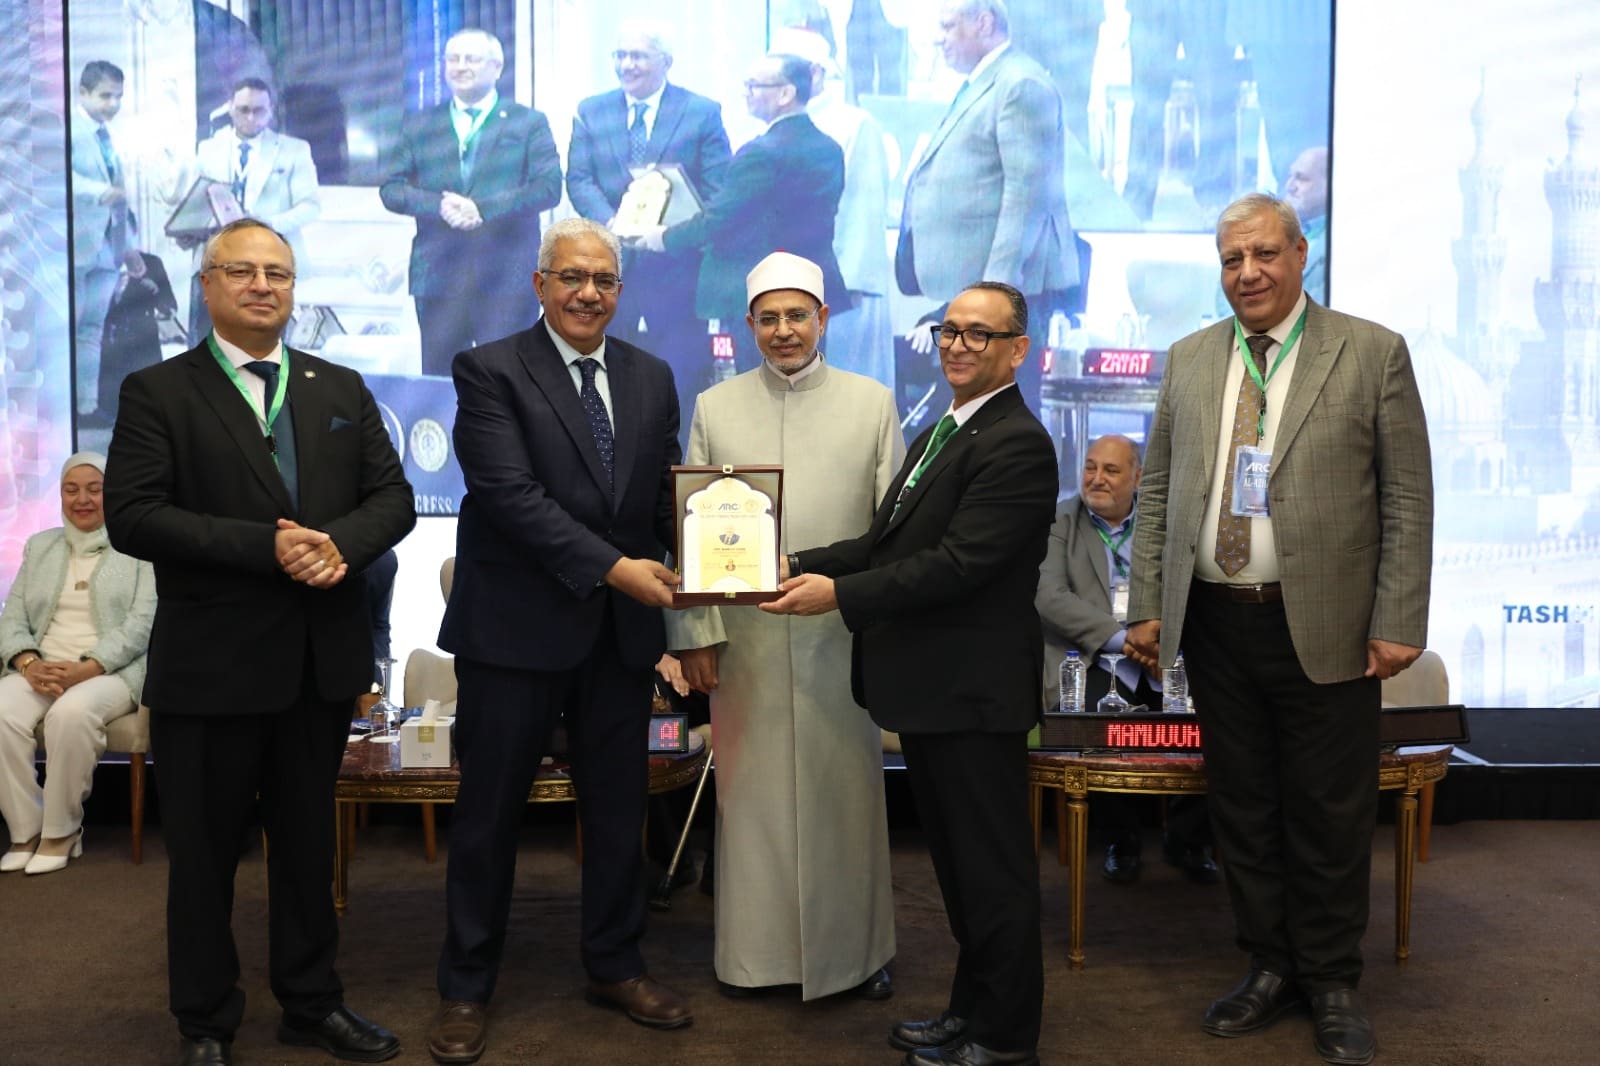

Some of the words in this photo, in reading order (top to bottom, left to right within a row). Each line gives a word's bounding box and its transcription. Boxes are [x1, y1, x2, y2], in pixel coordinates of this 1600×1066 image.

[1100, 351, 1151, 374] ZAYAT
[414, 495, 453, 514] GRESS
[1502, 604, 1594, 623] TASH
